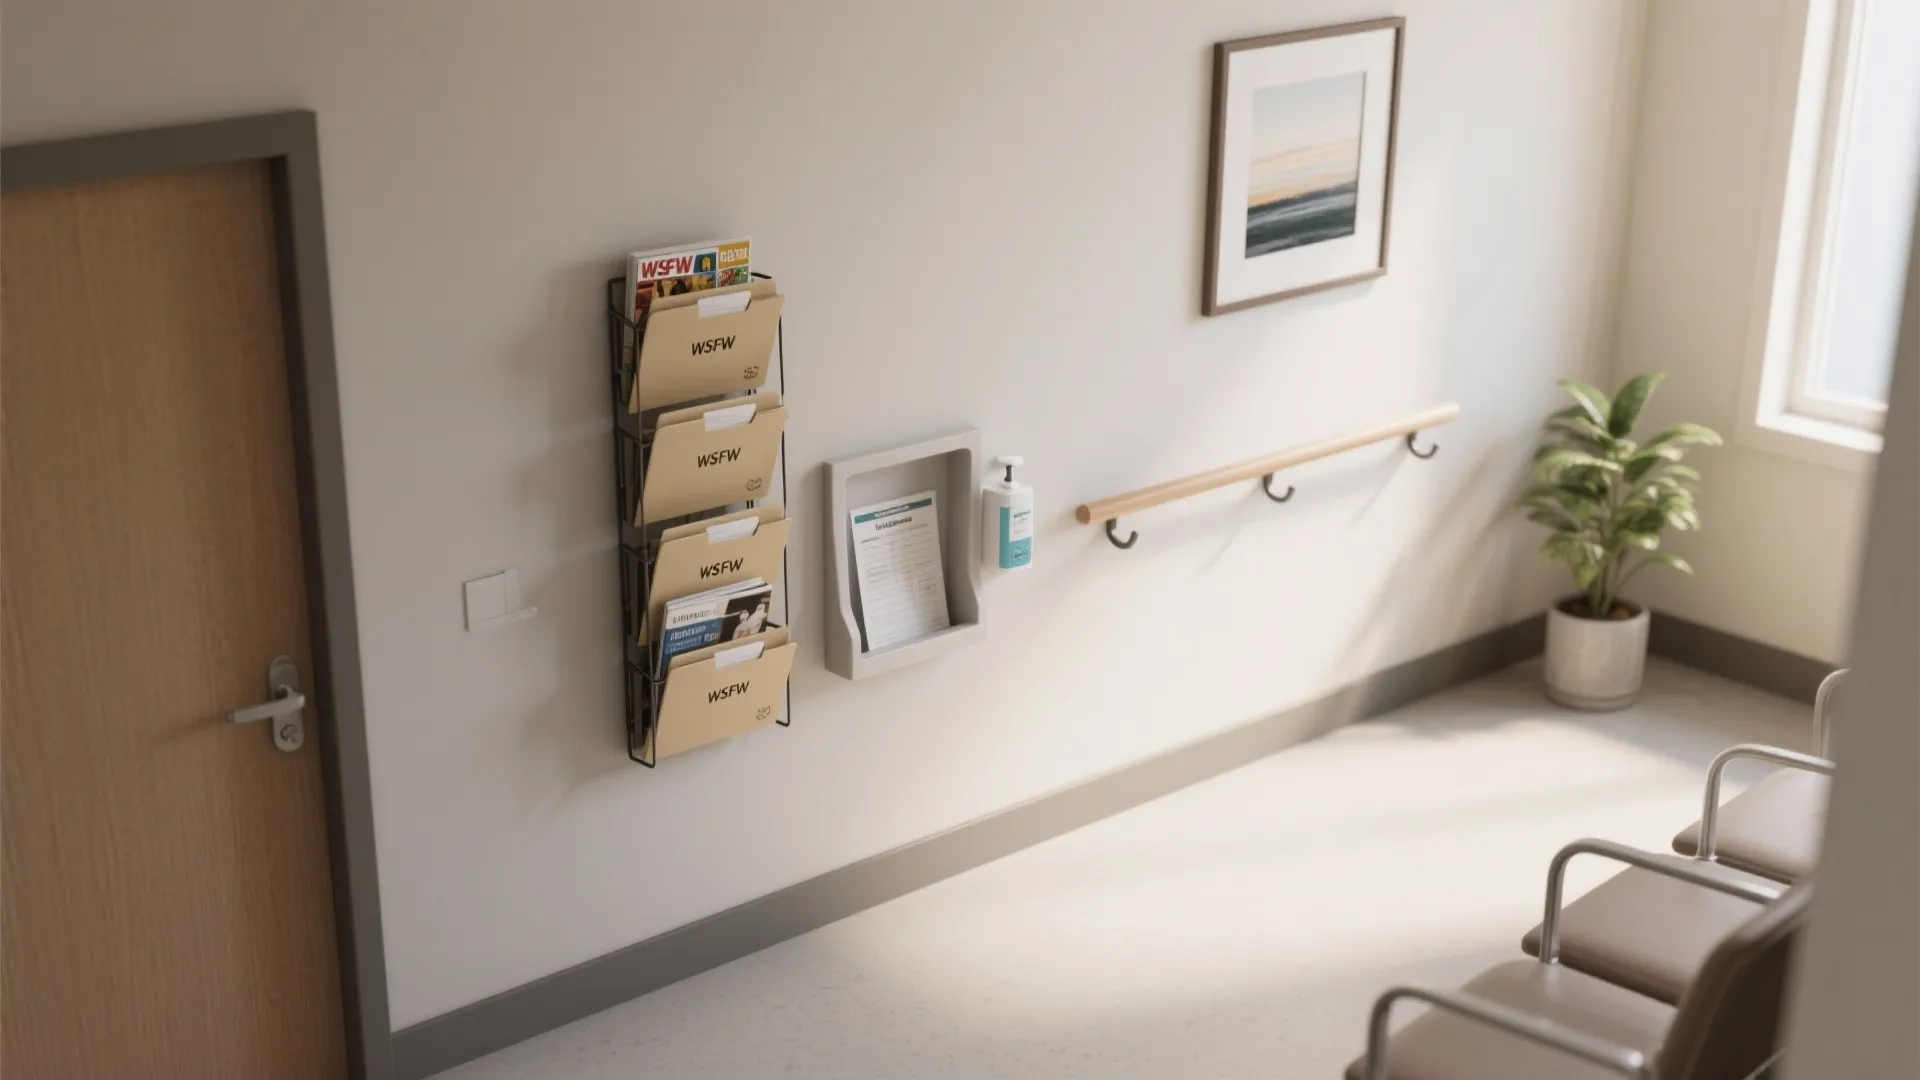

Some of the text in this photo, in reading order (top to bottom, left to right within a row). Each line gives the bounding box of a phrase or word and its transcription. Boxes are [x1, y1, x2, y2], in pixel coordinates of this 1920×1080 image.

[641, 255, 694, 279] WSFW
[691, 335, 736, 356] WSFW
[697, 447, 741, 468] WSFW
[700, 557, 744, 579] WSFW
[708, 680, 750, 704] WSFW
